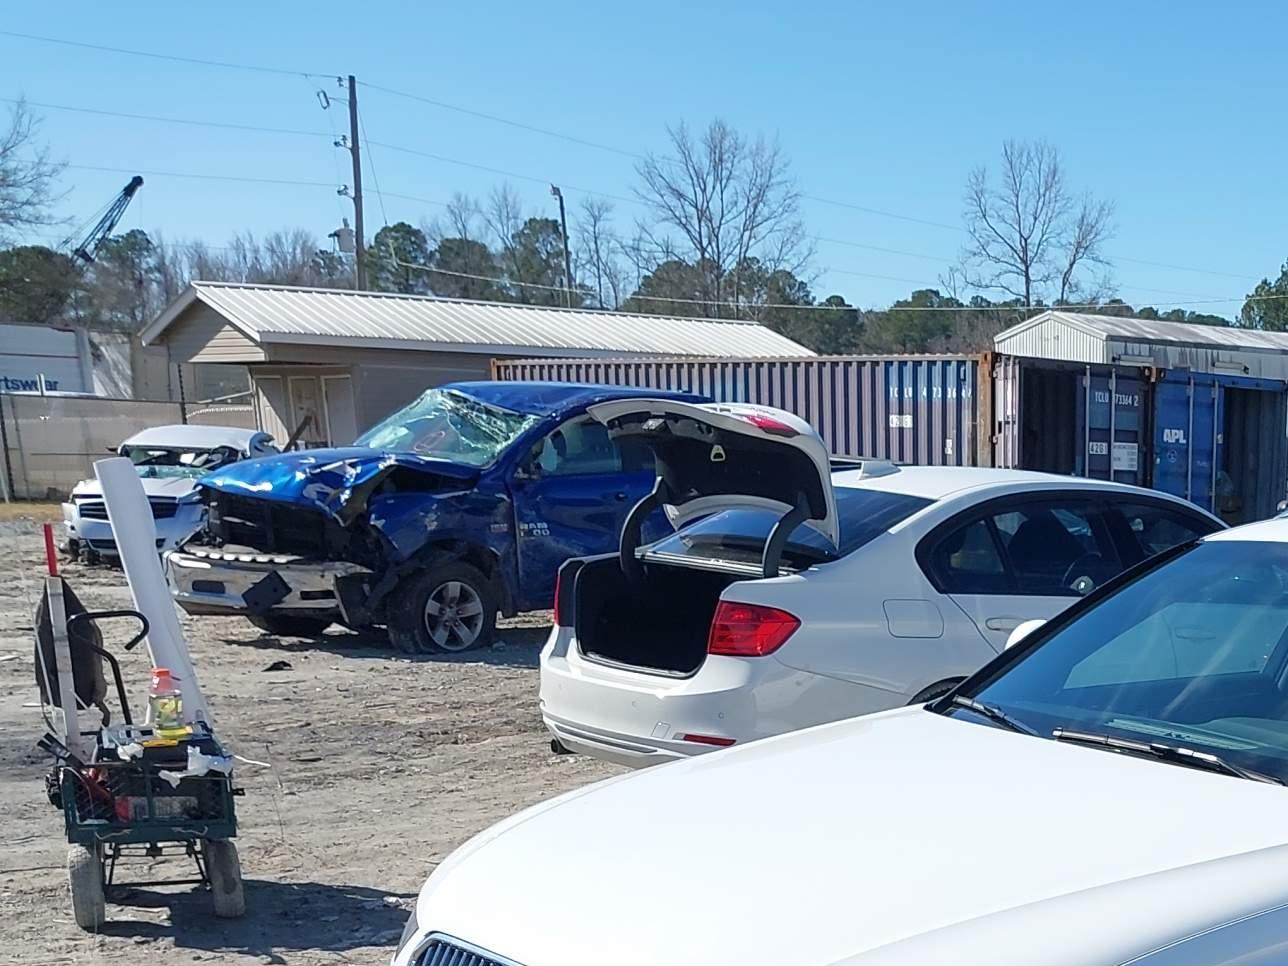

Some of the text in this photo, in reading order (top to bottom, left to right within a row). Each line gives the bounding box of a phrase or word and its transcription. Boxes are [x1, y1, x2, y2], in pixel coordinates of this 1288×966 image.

[1095, 391, 1109, 403] TCLU
[1163, 429, 1187, 444] APL
[520, 522, 548, 530] RAM
[520, 529, 551, 537] 100
